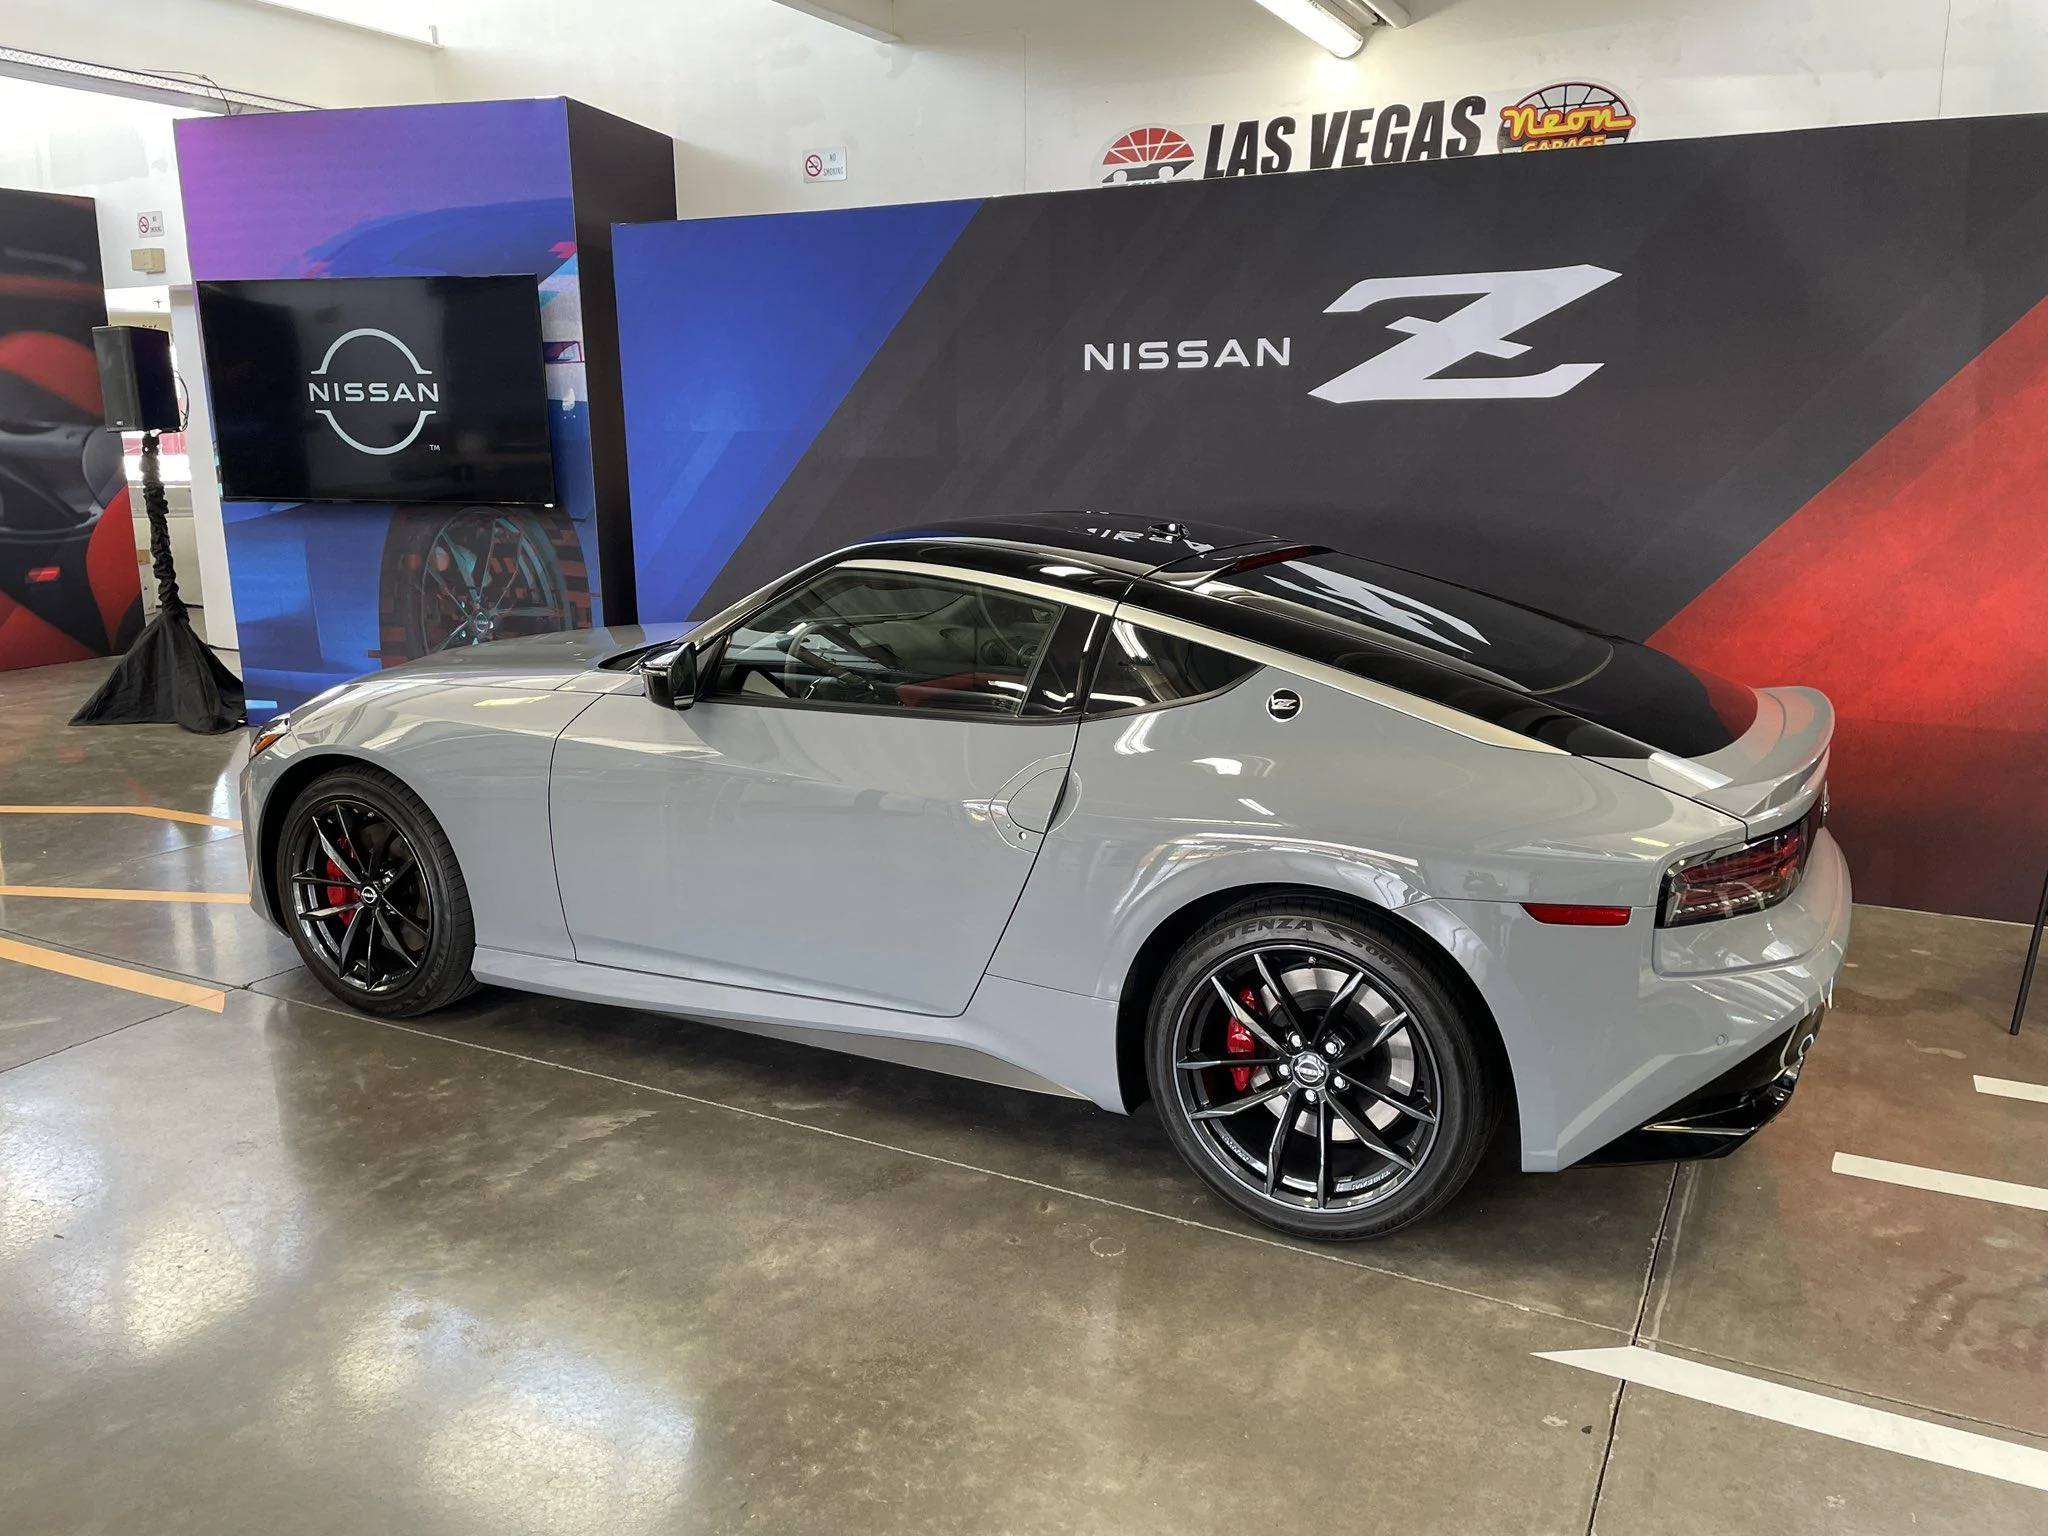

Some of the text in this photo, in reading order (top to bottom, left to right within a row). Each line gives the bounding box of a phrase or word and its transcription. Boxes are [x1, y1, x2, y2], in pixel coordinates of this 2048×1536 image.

[1203, 95, 1487, 179] LAS VEGAS
[1083, 263, 1623, 403] NISSAN Z
[308, 382, 439, 402] NISSAN
